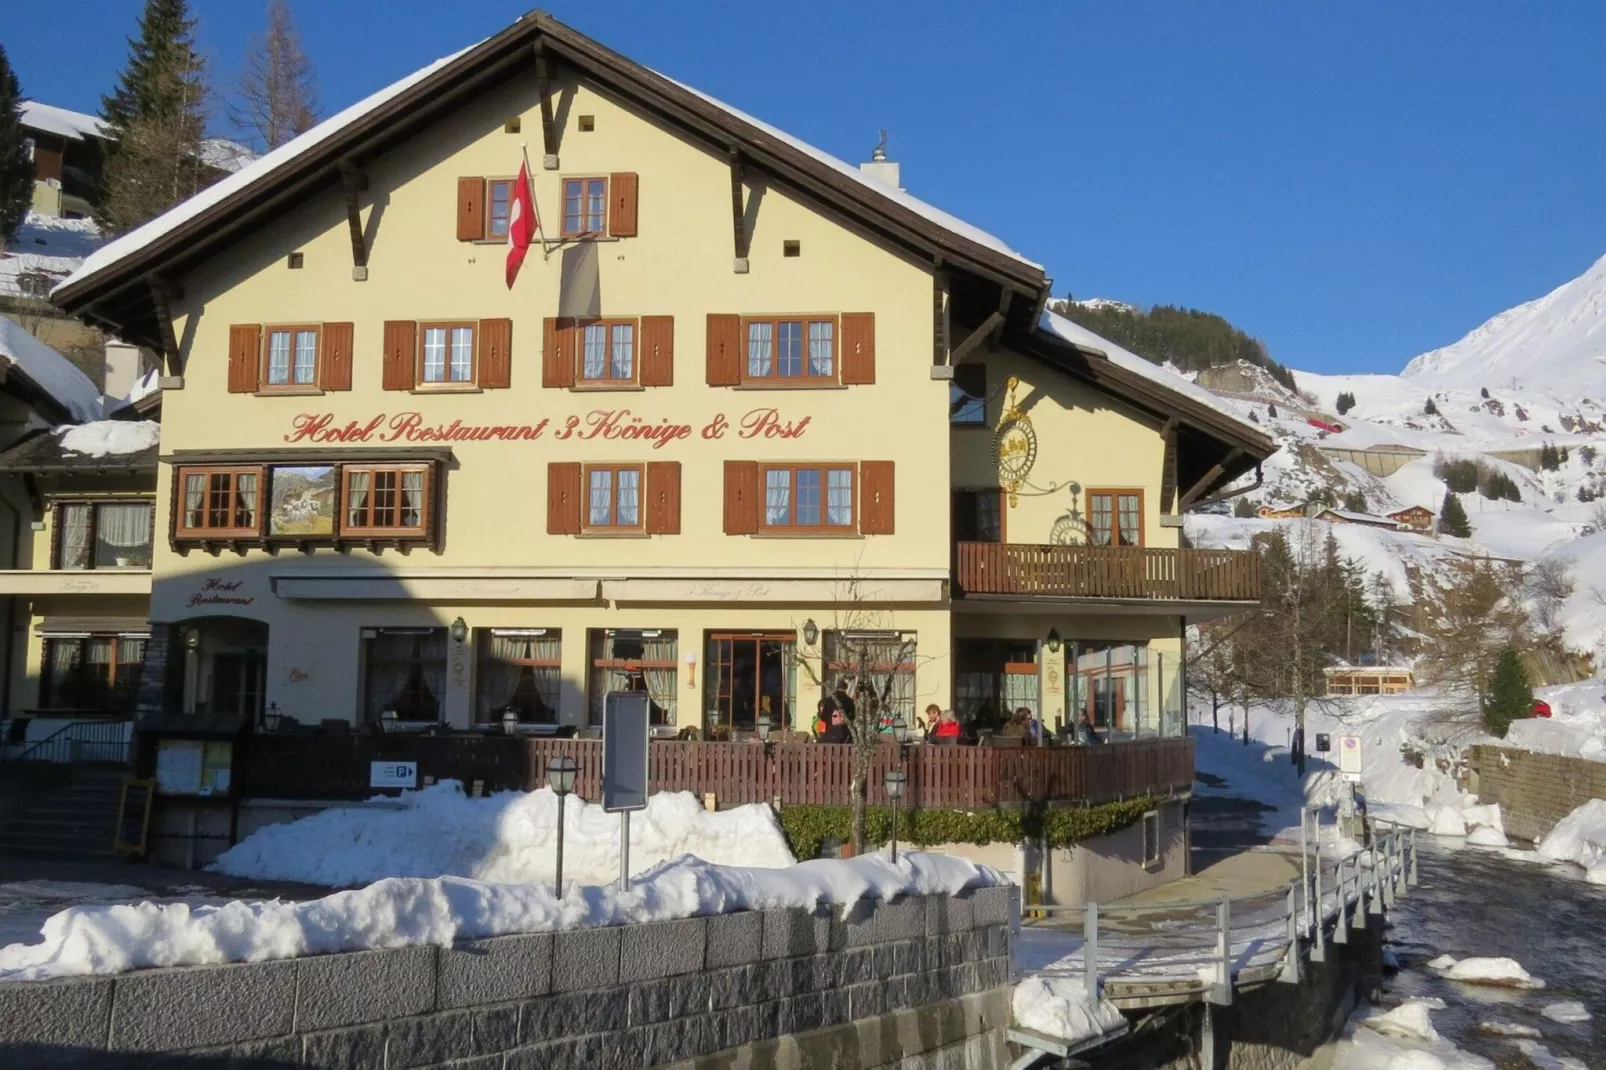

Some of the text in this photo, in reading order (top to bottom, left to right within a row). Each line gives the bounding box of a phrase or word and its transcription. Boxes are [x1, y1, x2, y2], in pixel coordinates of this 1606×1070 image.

[284, 408, 812, 449] Hotel Restaurant 3 Könige & Post
[201, 578, 244, 592] Hotel
[185, 592, 255, 608] Restaurant
